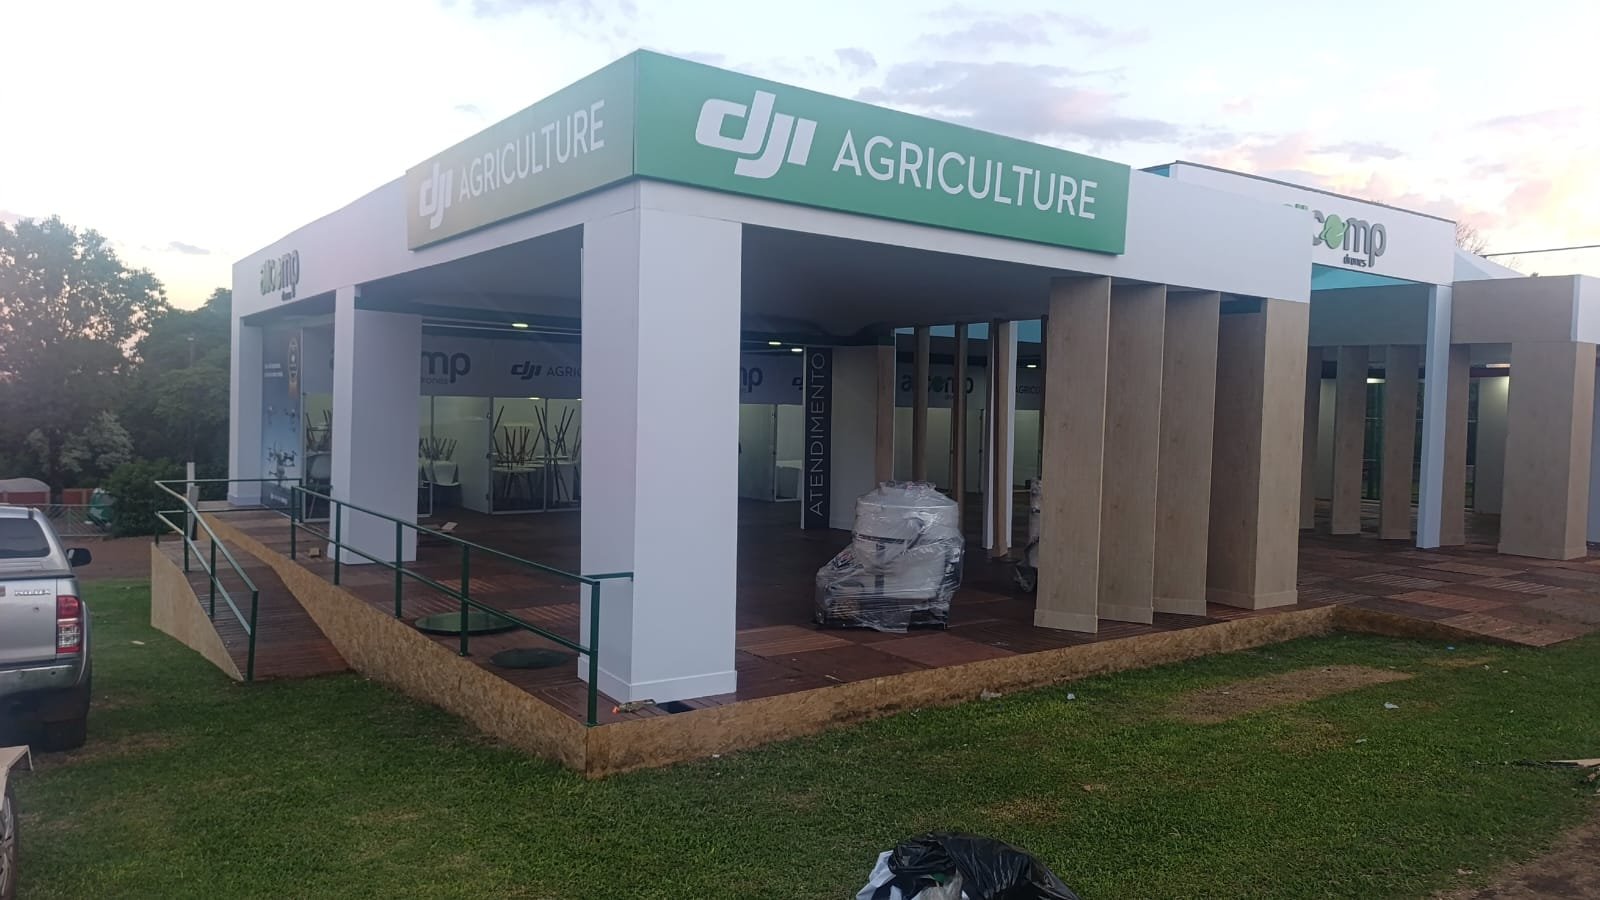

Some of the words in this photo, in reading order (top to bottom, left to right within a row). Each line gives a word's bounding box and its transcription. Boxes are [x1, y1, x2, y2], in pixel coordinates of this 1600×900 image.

[459, 99, 605, 201] AGRICULTURE
[832, 129, 1098, 220] AGRICULTURE
[810, 353, 825, 517] ATENDIMENTO
